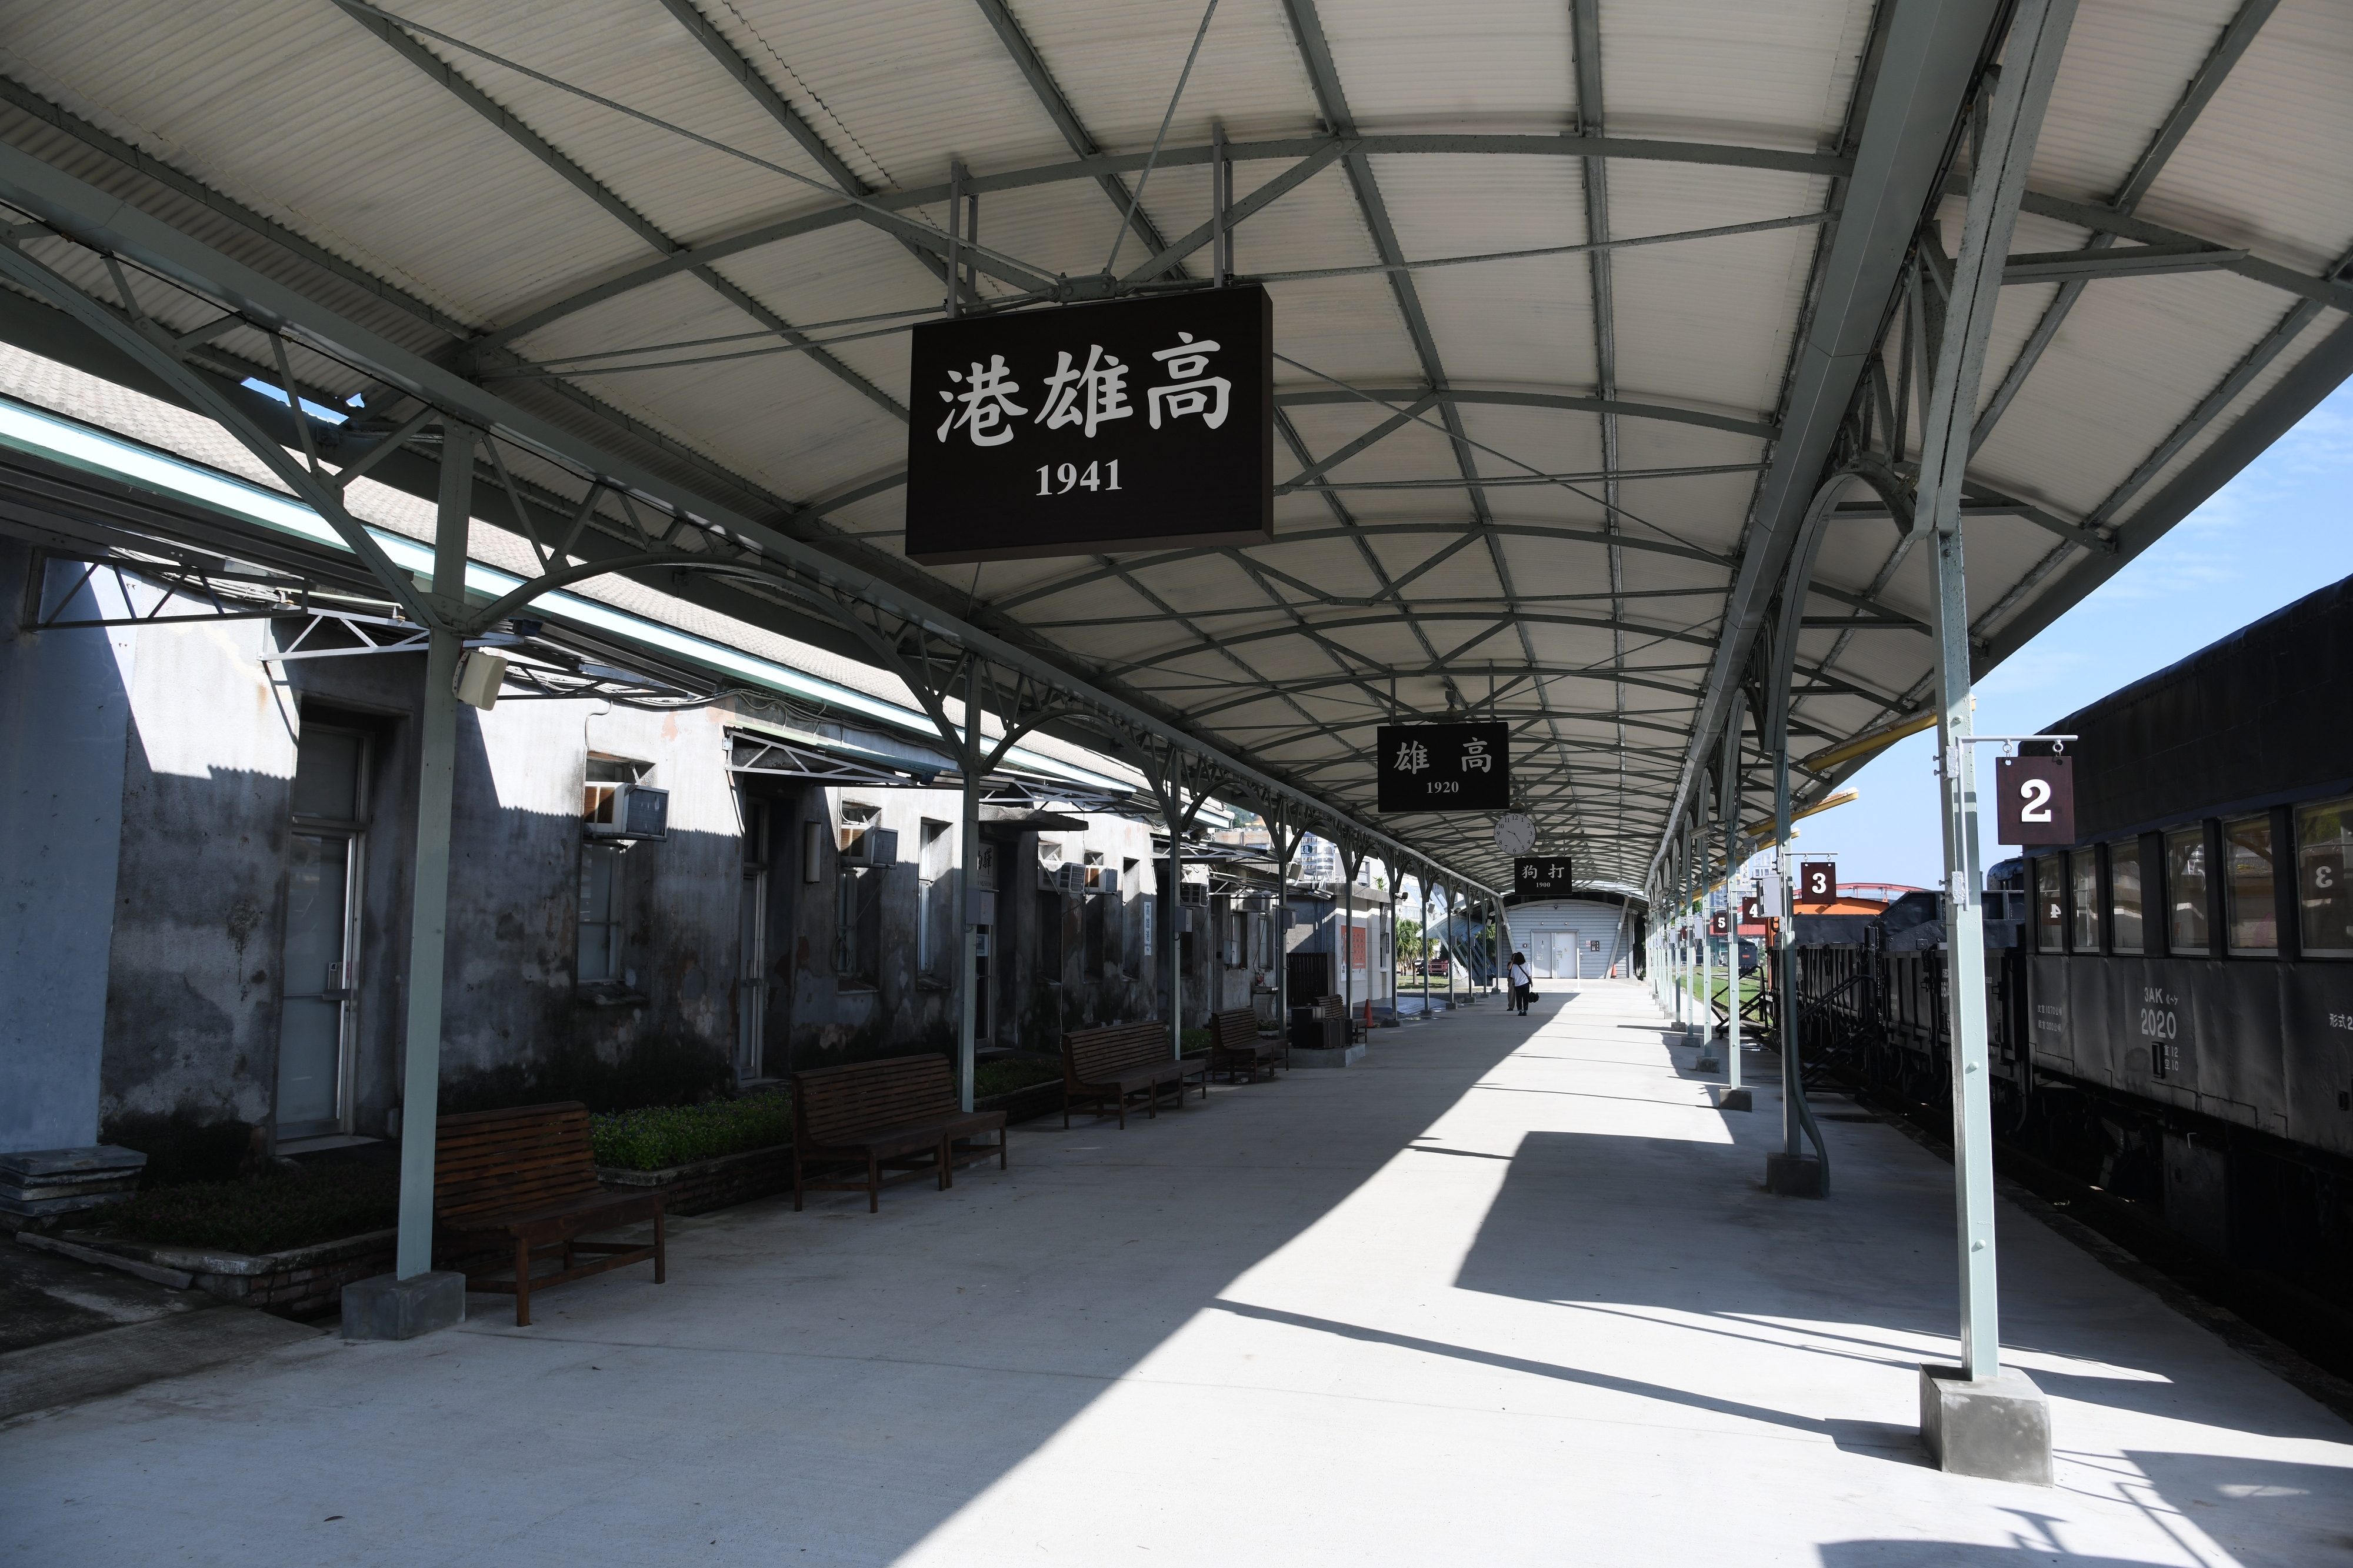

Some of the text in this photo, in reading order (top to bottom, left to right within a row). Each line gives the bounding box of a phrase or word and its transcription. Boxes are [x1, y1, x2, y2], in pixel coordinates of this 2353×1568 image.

[1036, 459, 1122, 496] 1941
[1427, 781, 1459, 793] 1920
[2021, 779, 2051, 822] 2
[1812, 873, 1827, 894] 3
[1749, 903, 1758, 918] 4
[1718, 917, 1726, 928] 5
[2144, 987, 2163, 1004] 3AK
[2141, 1007, 2177, 1040] 2020
[2171, 1046, 2178, 1058] 12
[2172, 1059, 2179, 1072] 10
